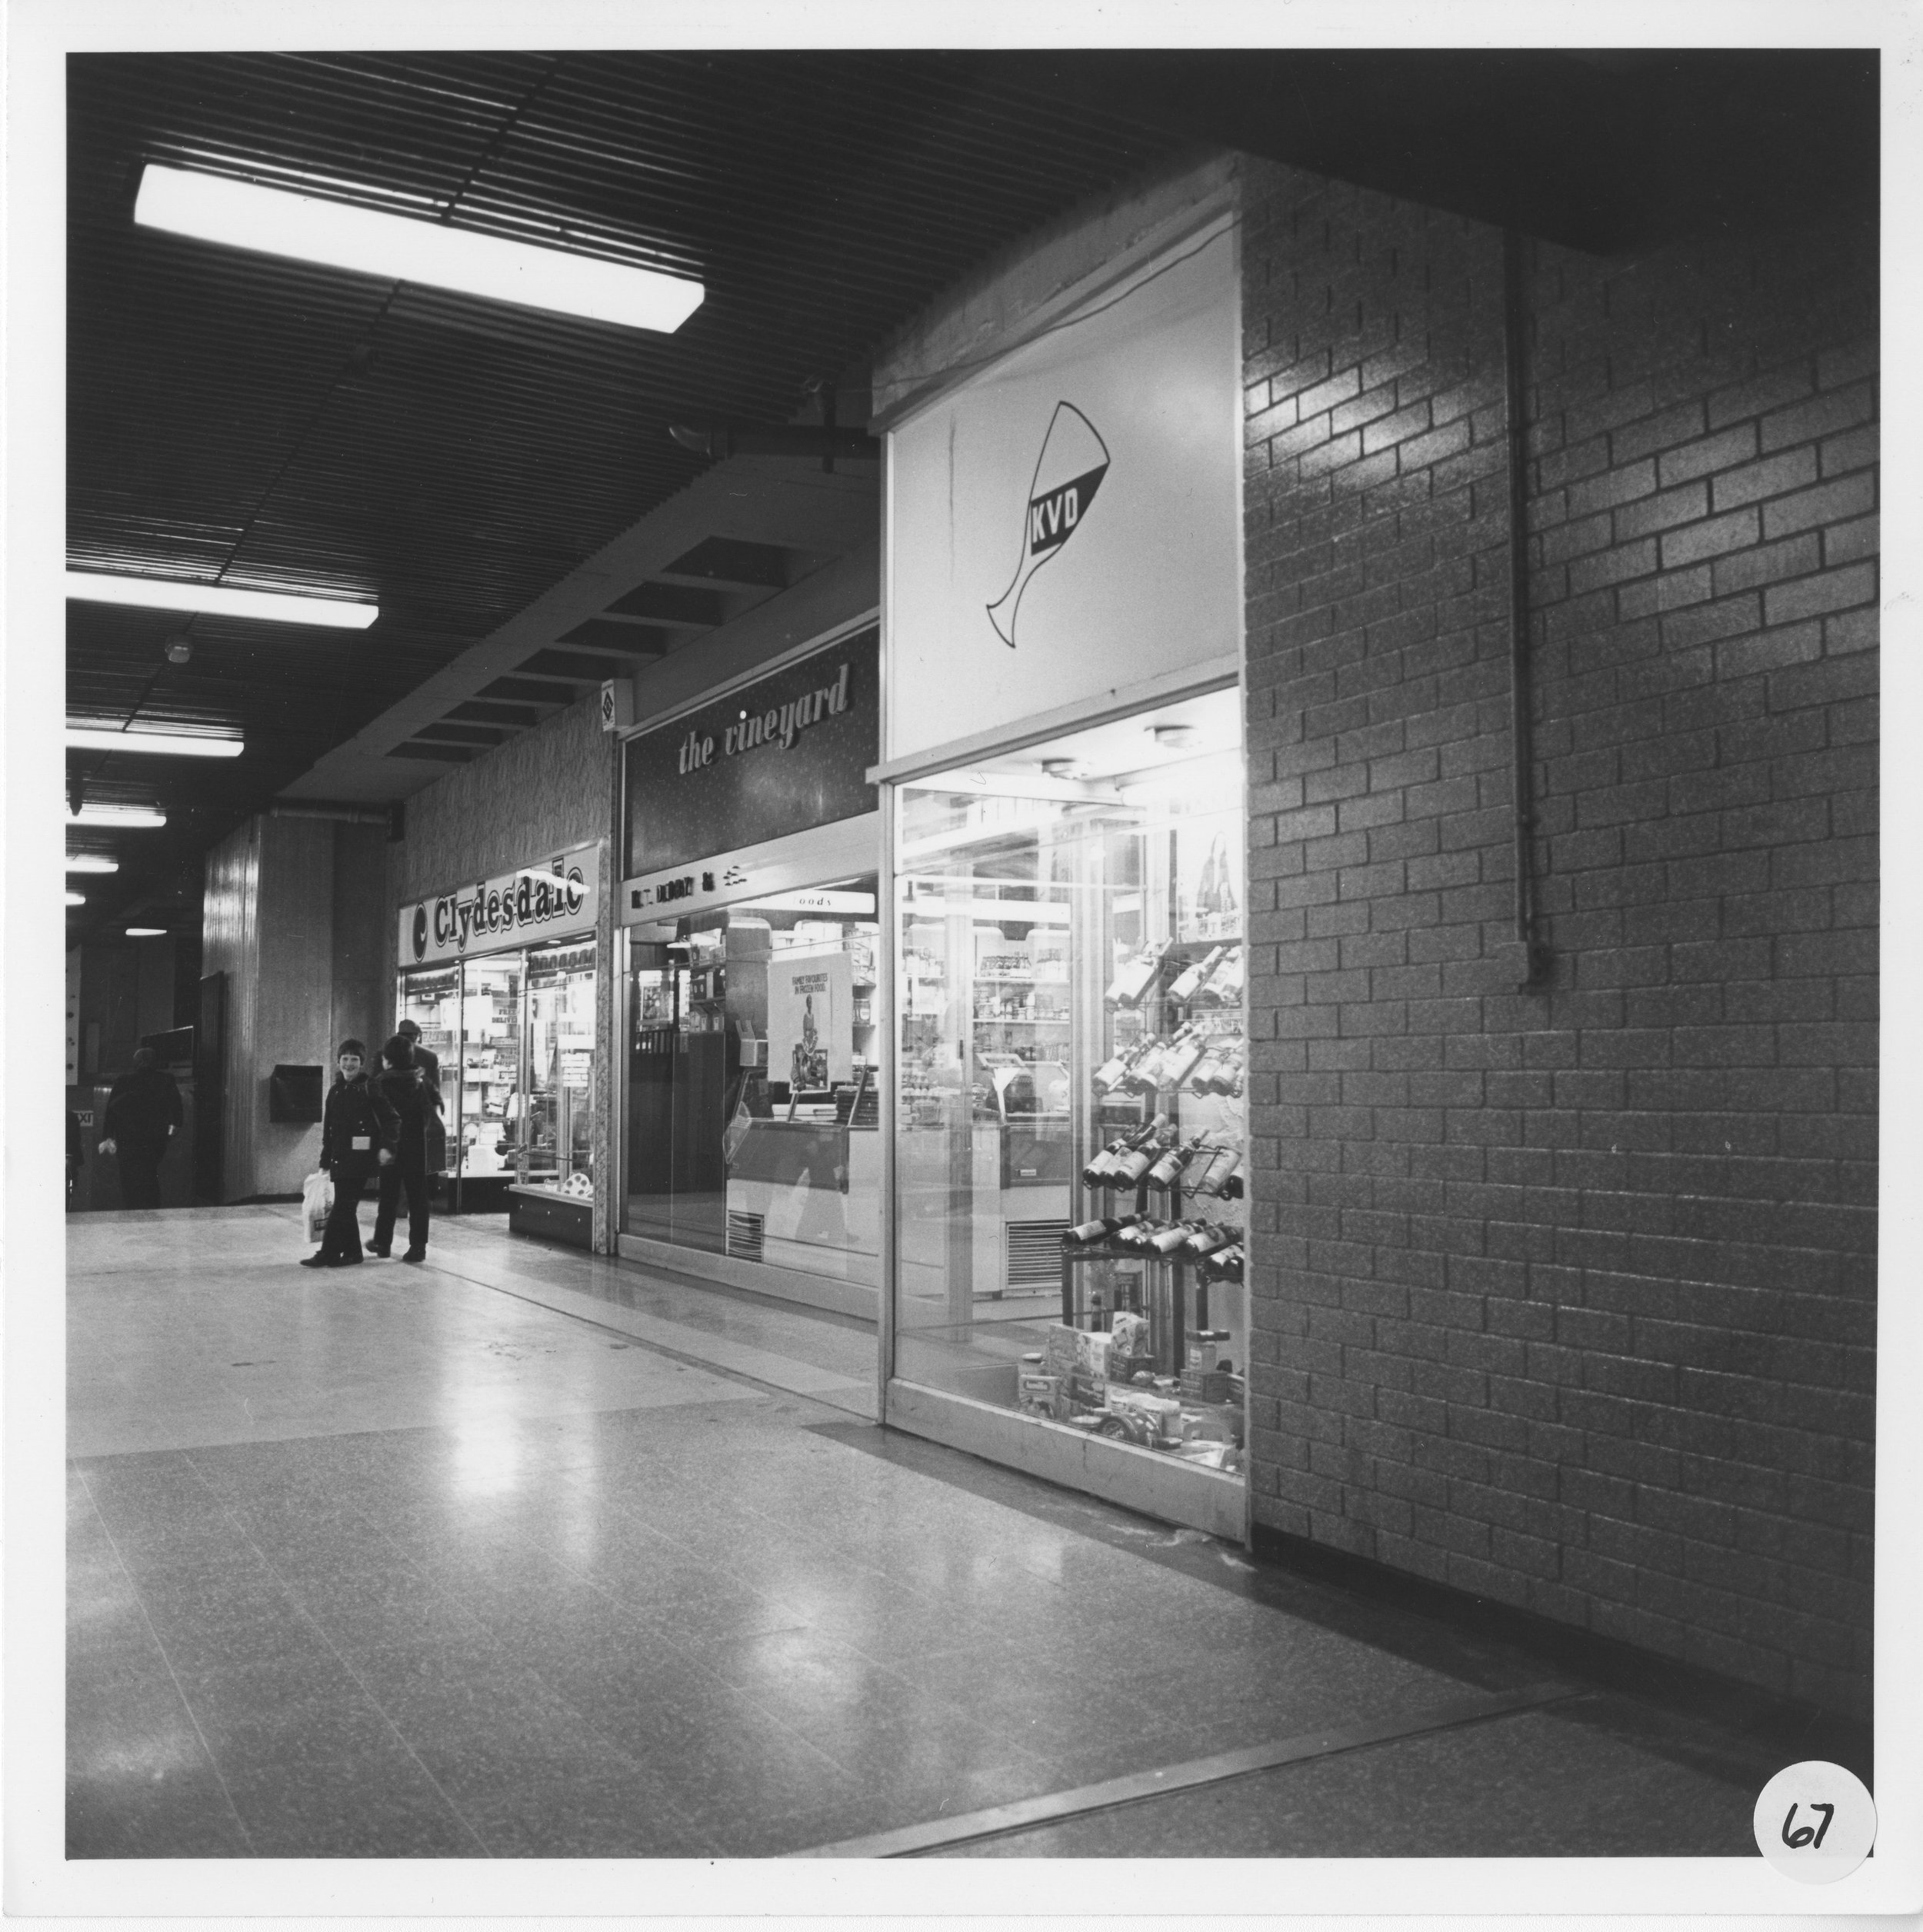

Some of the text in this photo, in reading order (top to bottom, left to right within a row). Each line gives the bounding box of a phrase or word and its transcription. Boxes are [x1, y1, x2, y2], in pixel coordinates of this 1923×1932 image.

[1032, 488, 1078, 543] KVD
[679, 663, 849, 774] the vineyard
[434, 857, 584, 953] Clydesdale
[793, 897, 831, 906] oods
[792, 973, 828, 985] FAMILY FAVOURITES
[795, 985, 799, 994] IN
[800, 984, 814, 994] FROZEN
